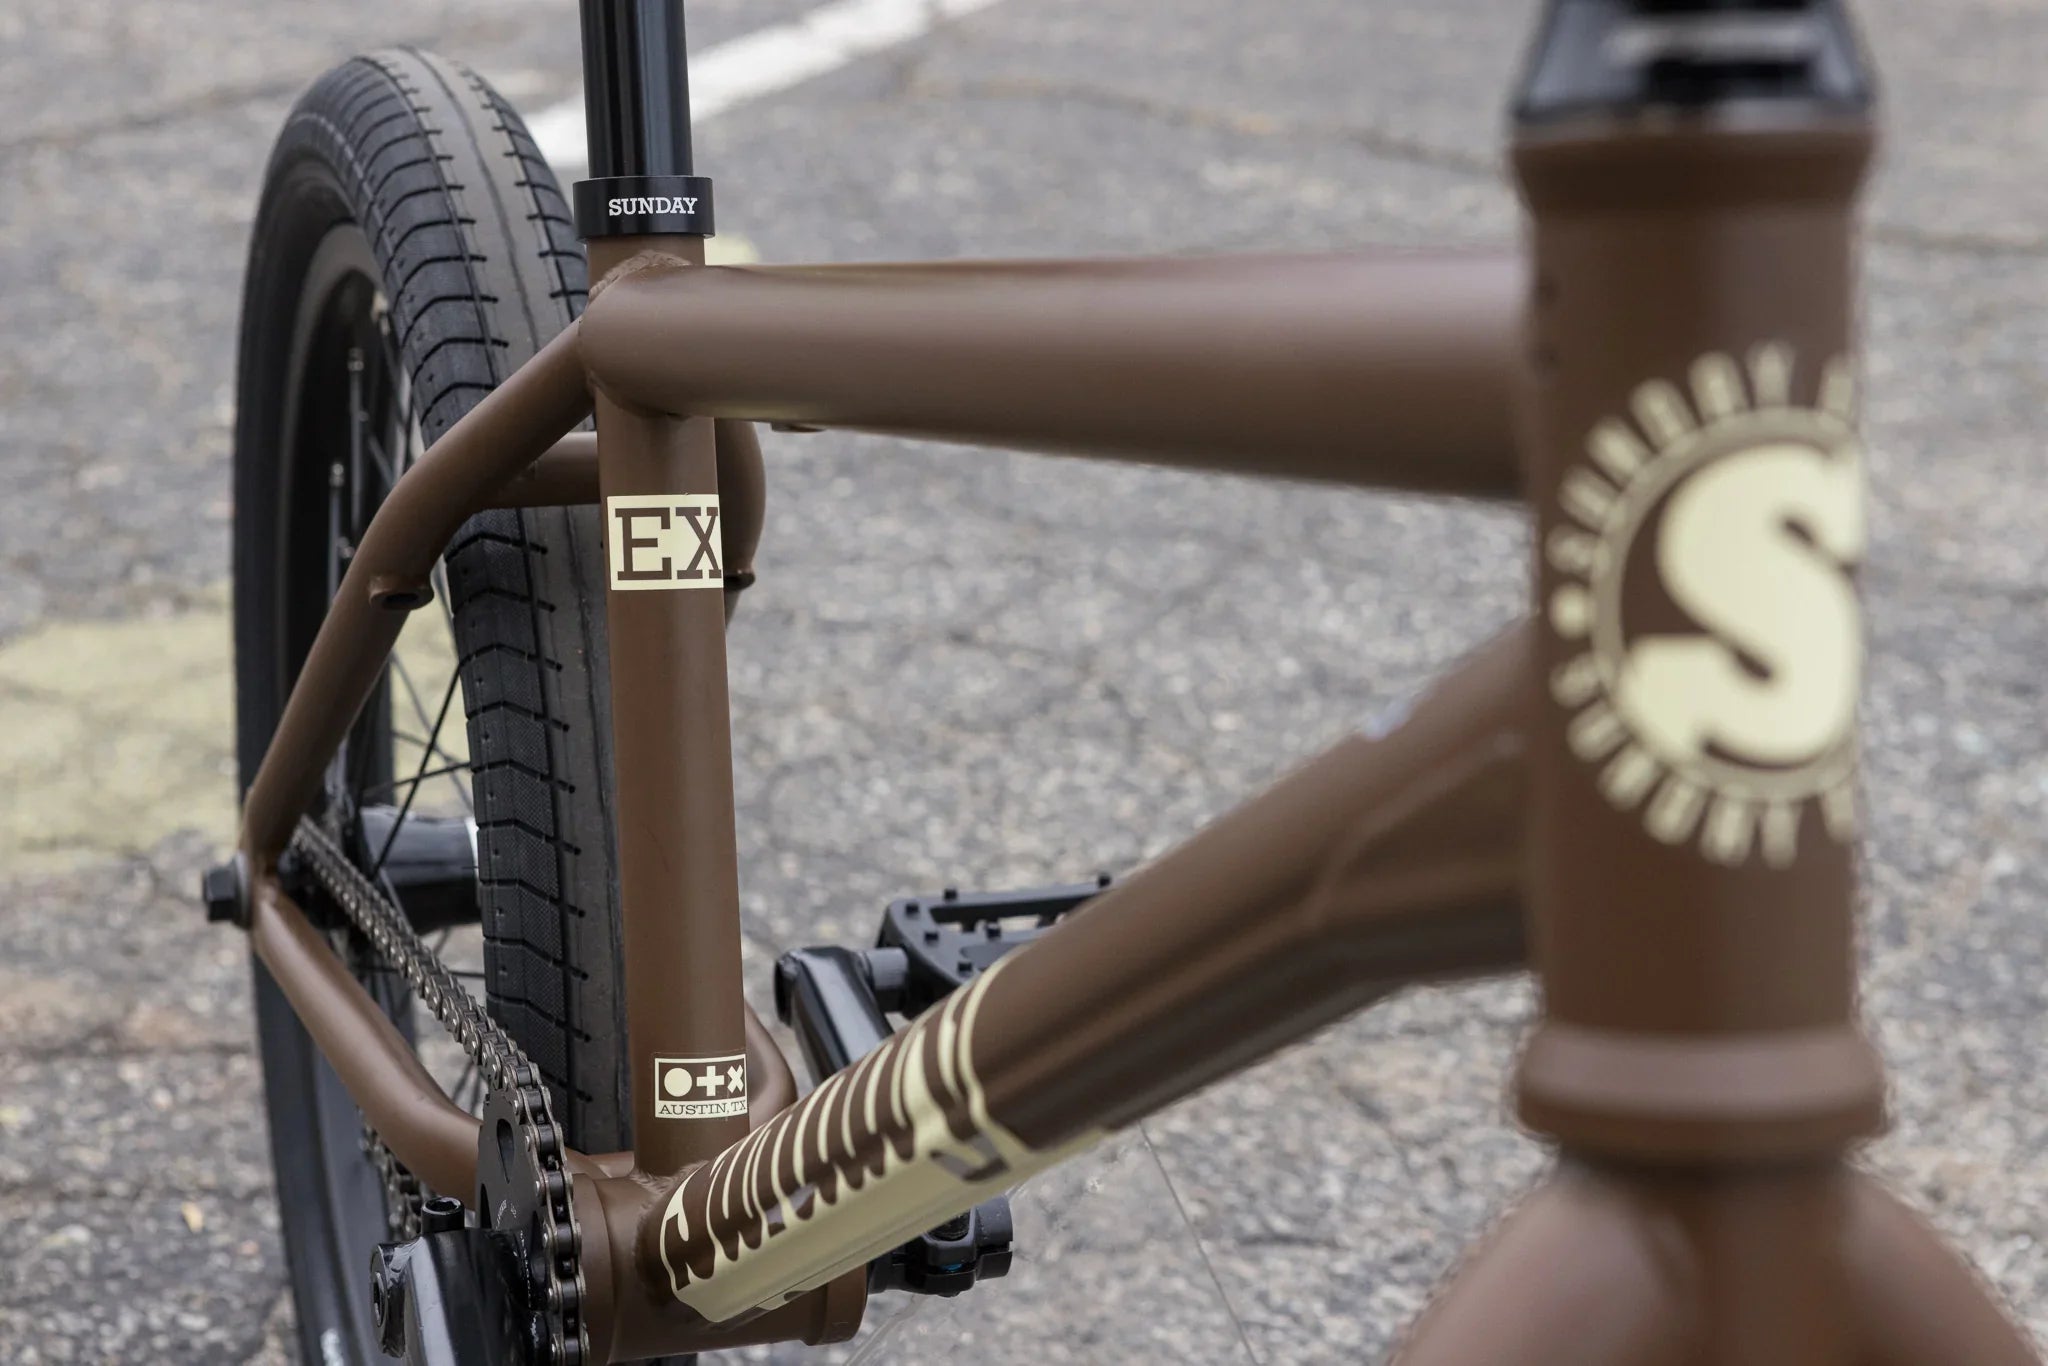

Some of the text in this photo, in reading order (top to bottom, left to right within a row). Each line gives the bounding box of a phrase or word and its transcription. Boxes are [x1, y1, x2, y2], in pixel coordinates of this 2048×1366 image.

[608, 197, 698, 216] SUNDAY
[615, 507, 722, 580] EX
[1615, 440, 1864, 767] S
[658, 1099, 747, 1116] AUSTIN, TX
